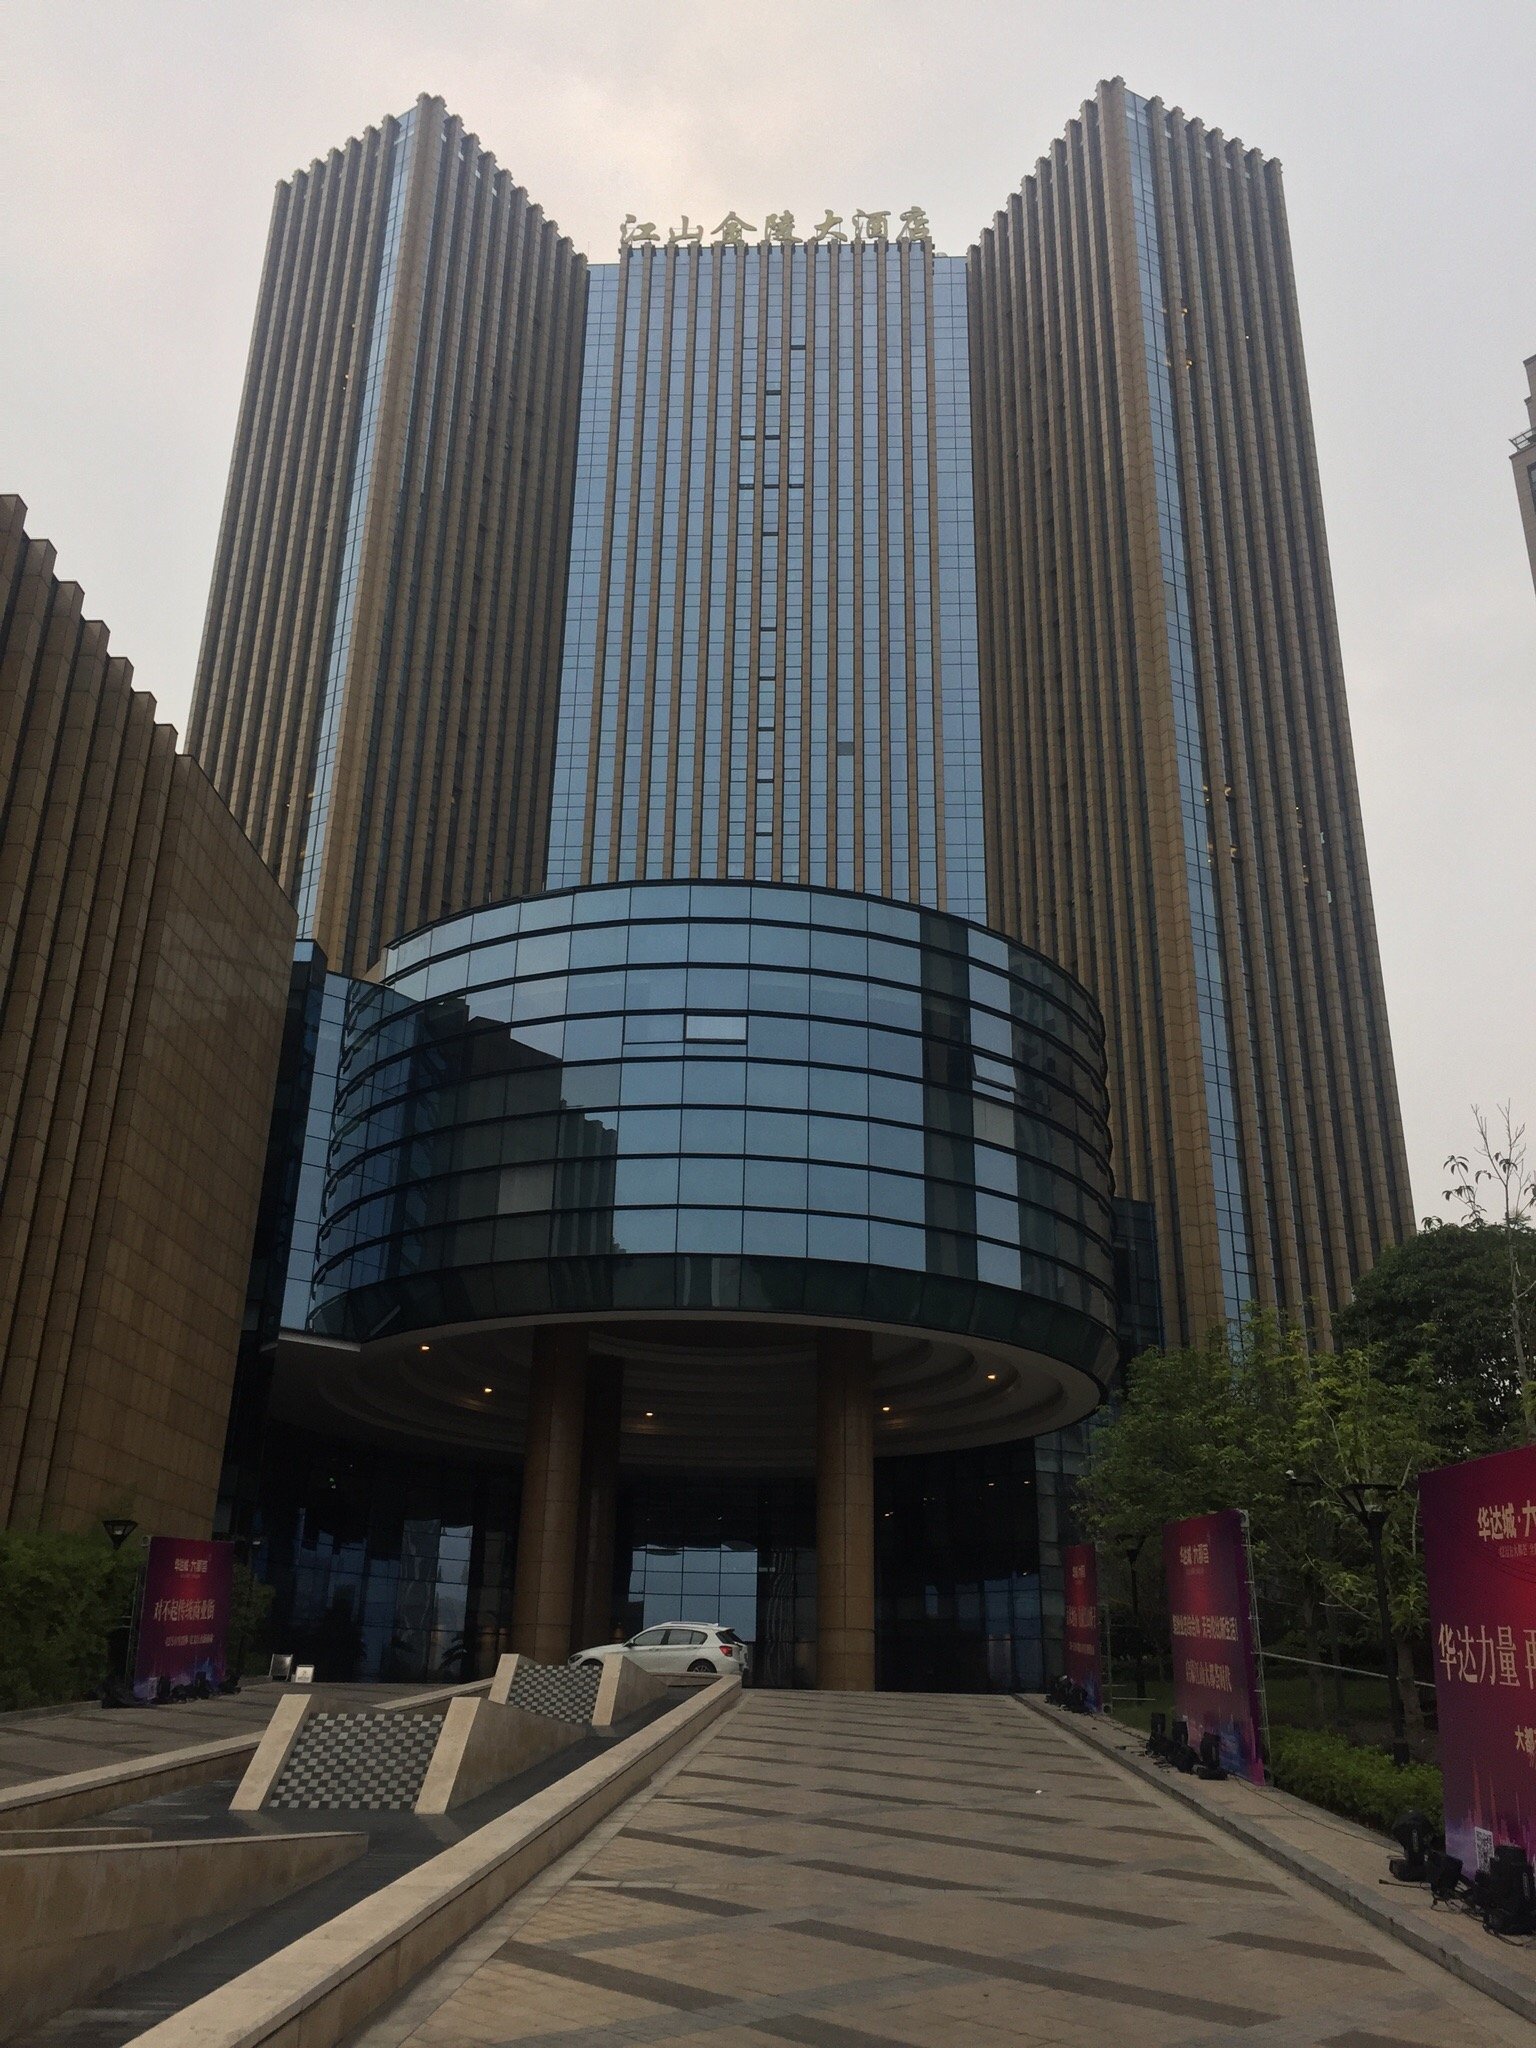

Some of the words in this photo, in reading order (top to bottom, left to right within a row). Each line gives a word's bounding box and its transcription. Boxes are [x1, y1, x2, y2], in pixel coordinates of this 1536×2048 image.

[620, 206, 930, 244] 江山金陵大酒店
[1438, 1622, 1520, 1687] 华达力量
